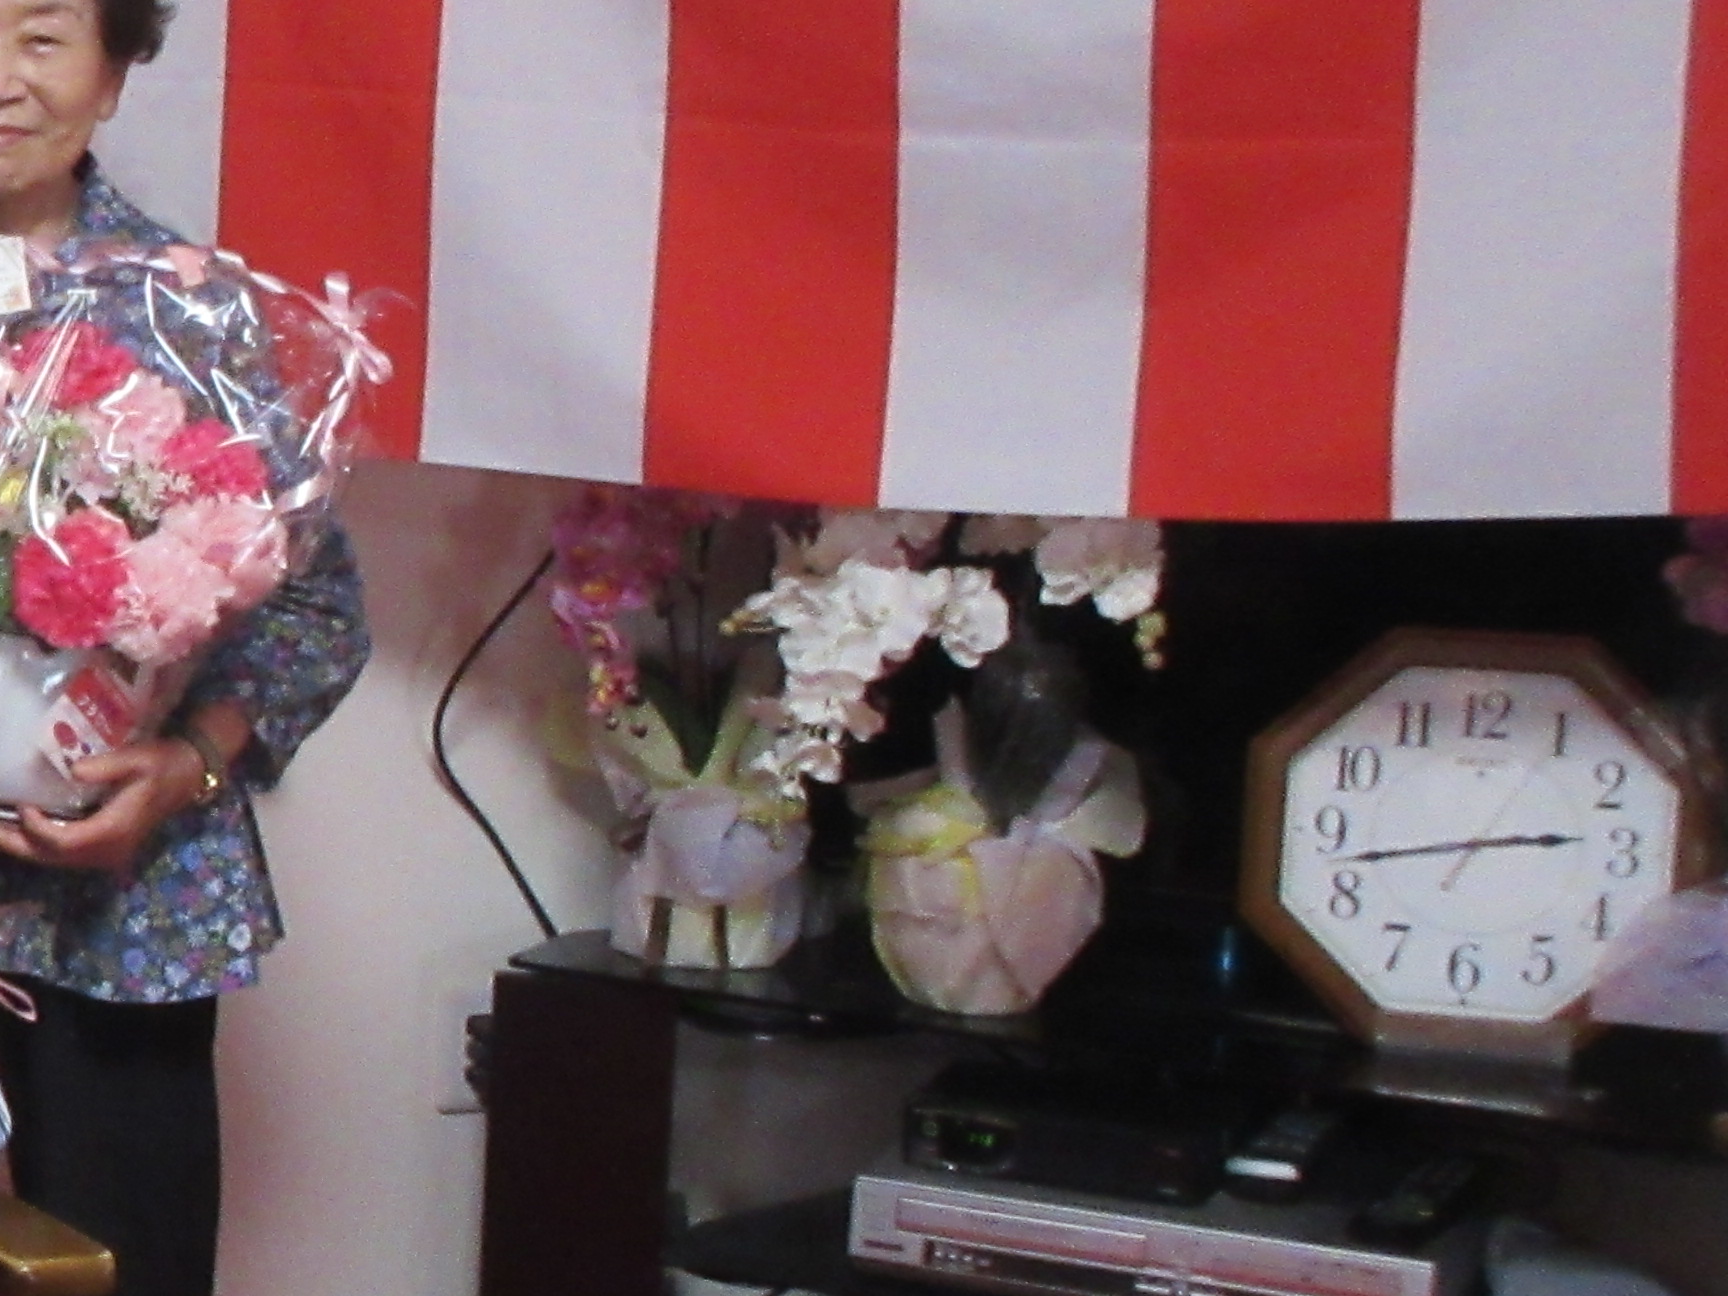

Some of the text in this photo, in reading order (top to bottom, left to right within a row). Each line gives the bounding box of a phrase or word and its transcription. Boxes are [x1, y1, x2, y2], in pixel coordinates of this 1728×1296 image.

[1395, 702, 1431, 748] 11
[1461, 691, 1512, 739] 12
[1553, 710, 1567, 757] 1
[1336, 744, 1381, 791] 10
[1594, 761, 1626, 810] 2
[1314, 805, 1347, 854] 9
[1606, 828, 1639, 878] 3
[1329, 871, 1361, 918] 8
[1382, 922, 1412, 972] 7
[1447, 943, 1481, 993] 6
[1521, 935, 1556, 986] 5
